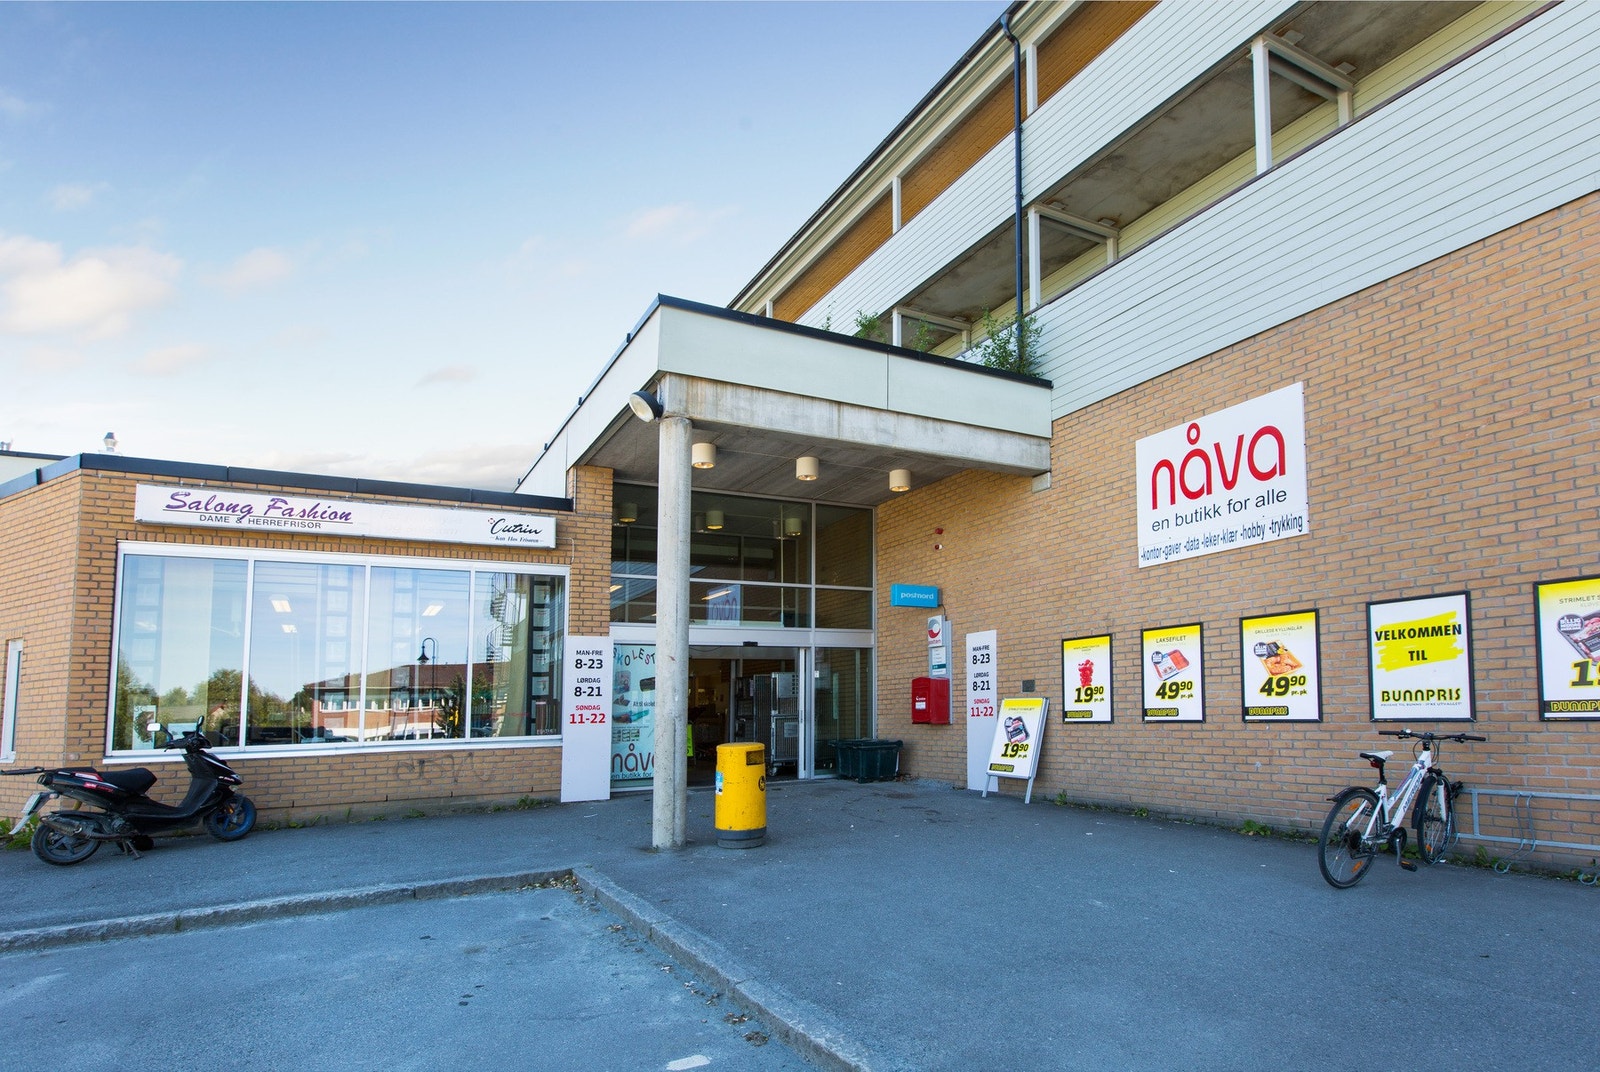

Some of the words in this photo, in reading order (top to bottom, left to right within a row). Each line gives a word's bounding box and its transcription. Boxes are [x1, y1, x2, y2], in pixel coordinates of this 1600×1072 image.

[1152, 422, 1286, 510] nåva
[165, 491, 254, 520] Salong
[264, 497, 352, 521] Fashion
[1152, 518, 1170, 532] en
[1175, 506, 1222, 527] butikk
[1227, 498, 1250, 513] for
[1255, 489, 1287, 508] alle
[199, 514, 230, 523] DAME
[248, 517, 322, 529] HERREFRISØR
[490, 518, 542, 534] Cutrin
[1269, 513, 1303, 536] -trykking
[900, 591, 934, 600] postnord
[1559, 594, 1595, 604] STRIMLET
[1375, 624, 1462, 641] VELKOMMEN
[1156, 635, 1186, 643] LAKSEFILET
[972, 653, 990, 664] 8-23
[1408, 650, 1427, 661] TIL
[575, 658, 603, 669] 8-23
[972, 680, 990, 691] 8-21
[574, 686, 602, 697] 8-21
[1381, 688, 1461, 702] BUNNPRIS
[971, 706, 993, 717] 11-22
[569, 713, 606, 724] 11-22
